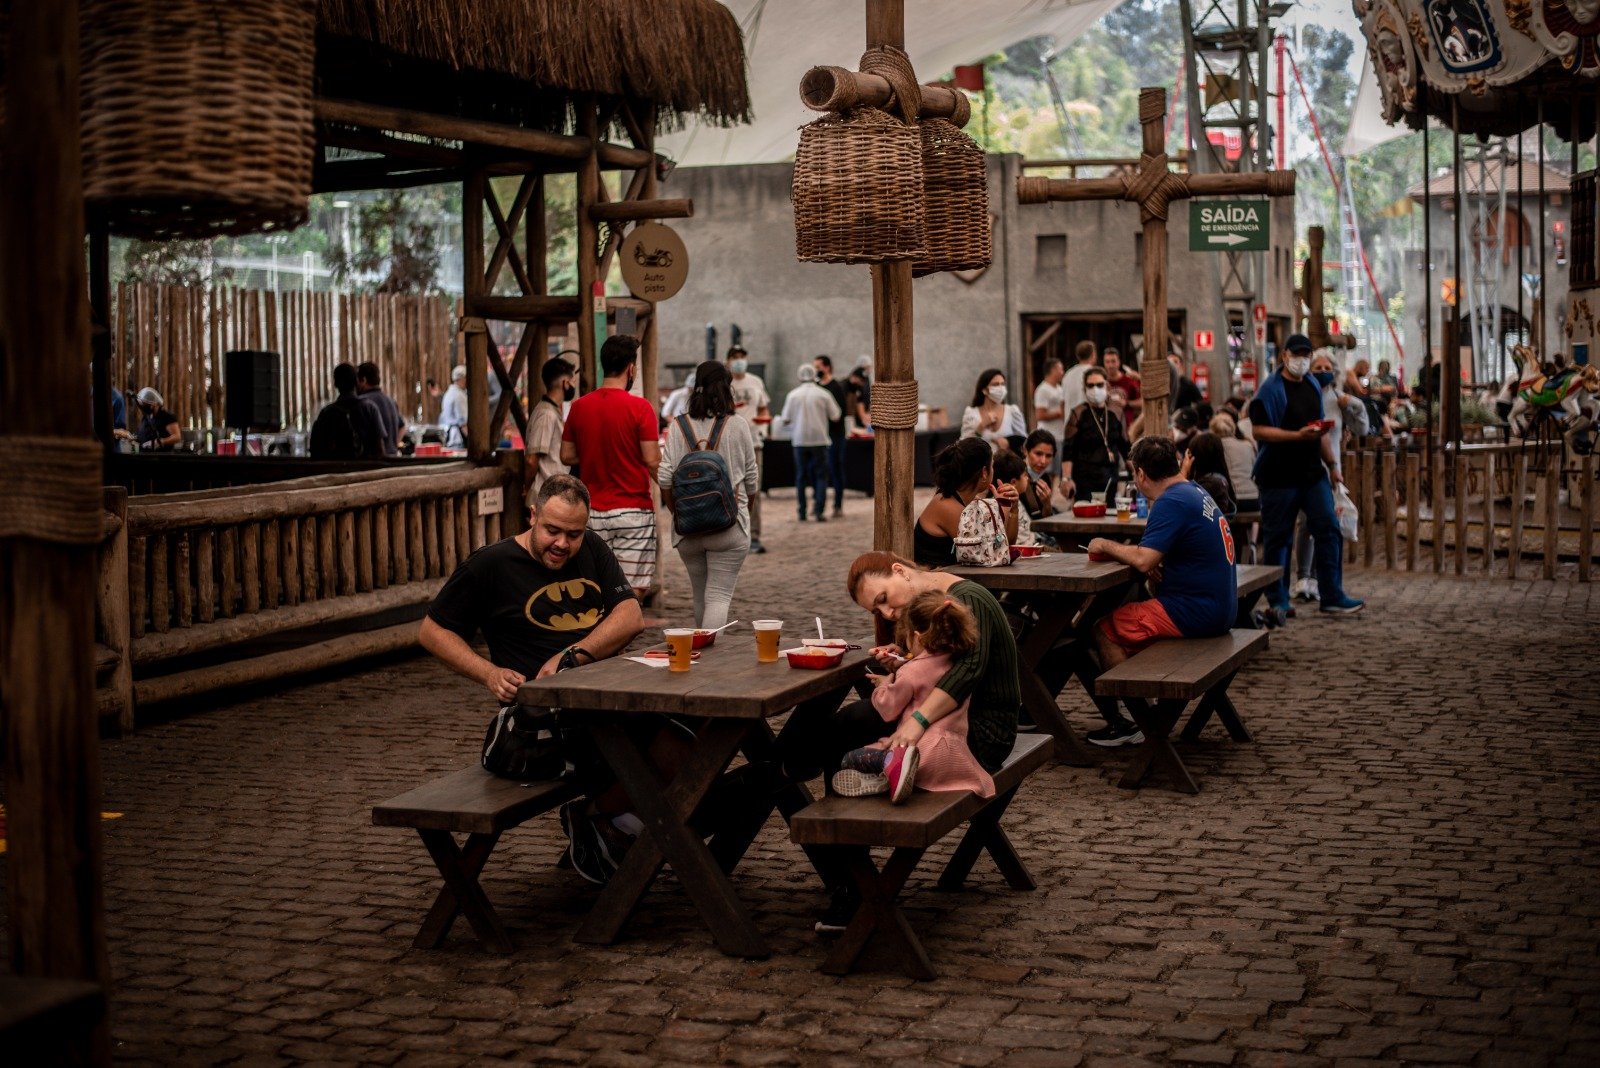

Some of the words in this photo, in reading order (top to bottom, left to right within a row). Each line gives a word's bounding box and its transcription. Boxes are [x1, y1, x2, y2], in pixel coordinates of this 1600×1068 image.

[1200, 204, 1259, 223] SAÍDA
[1201, 224, 1211, 232] DE
[1212, 223, 1260, 232] EMERGÊNCIA
[643, 273, 665, 281] Auto
[644, 284, 666, 294] pista
